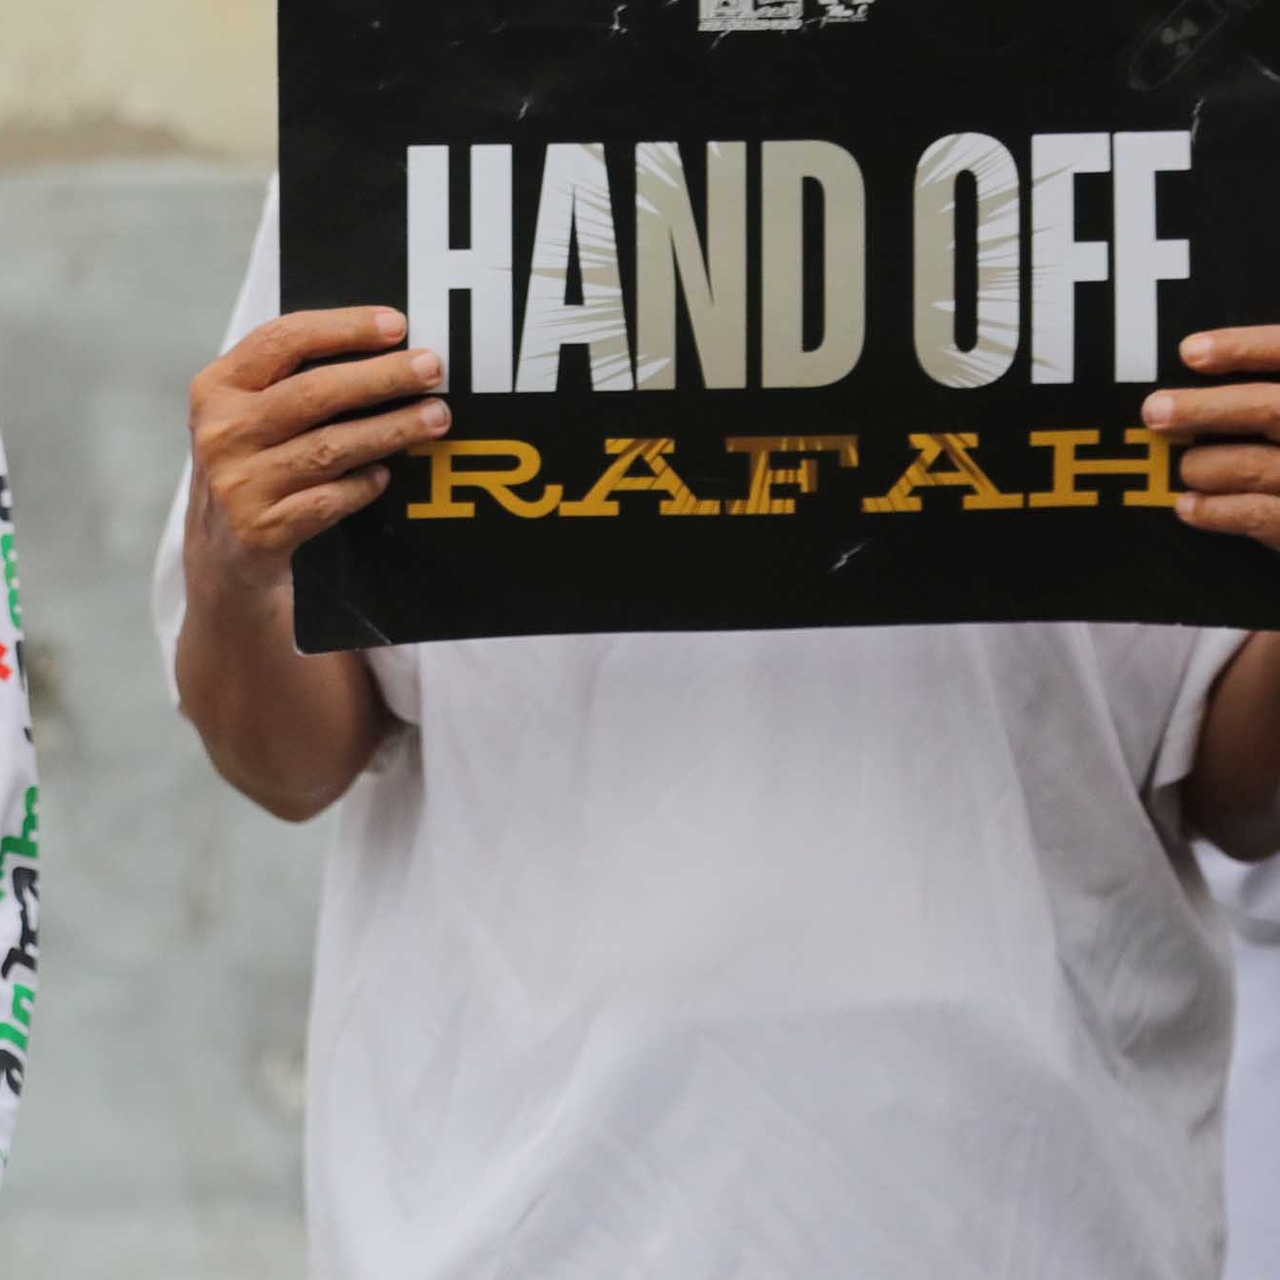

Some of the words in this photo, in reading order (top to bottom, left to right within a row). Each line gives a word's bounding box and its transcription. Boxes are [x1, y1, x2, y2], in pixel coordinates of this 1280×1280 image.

[406, 141, 865, 393] HAND
[913, 131, 1191, 388] OFF
[407, 429, 1184, 519] RAFAH
